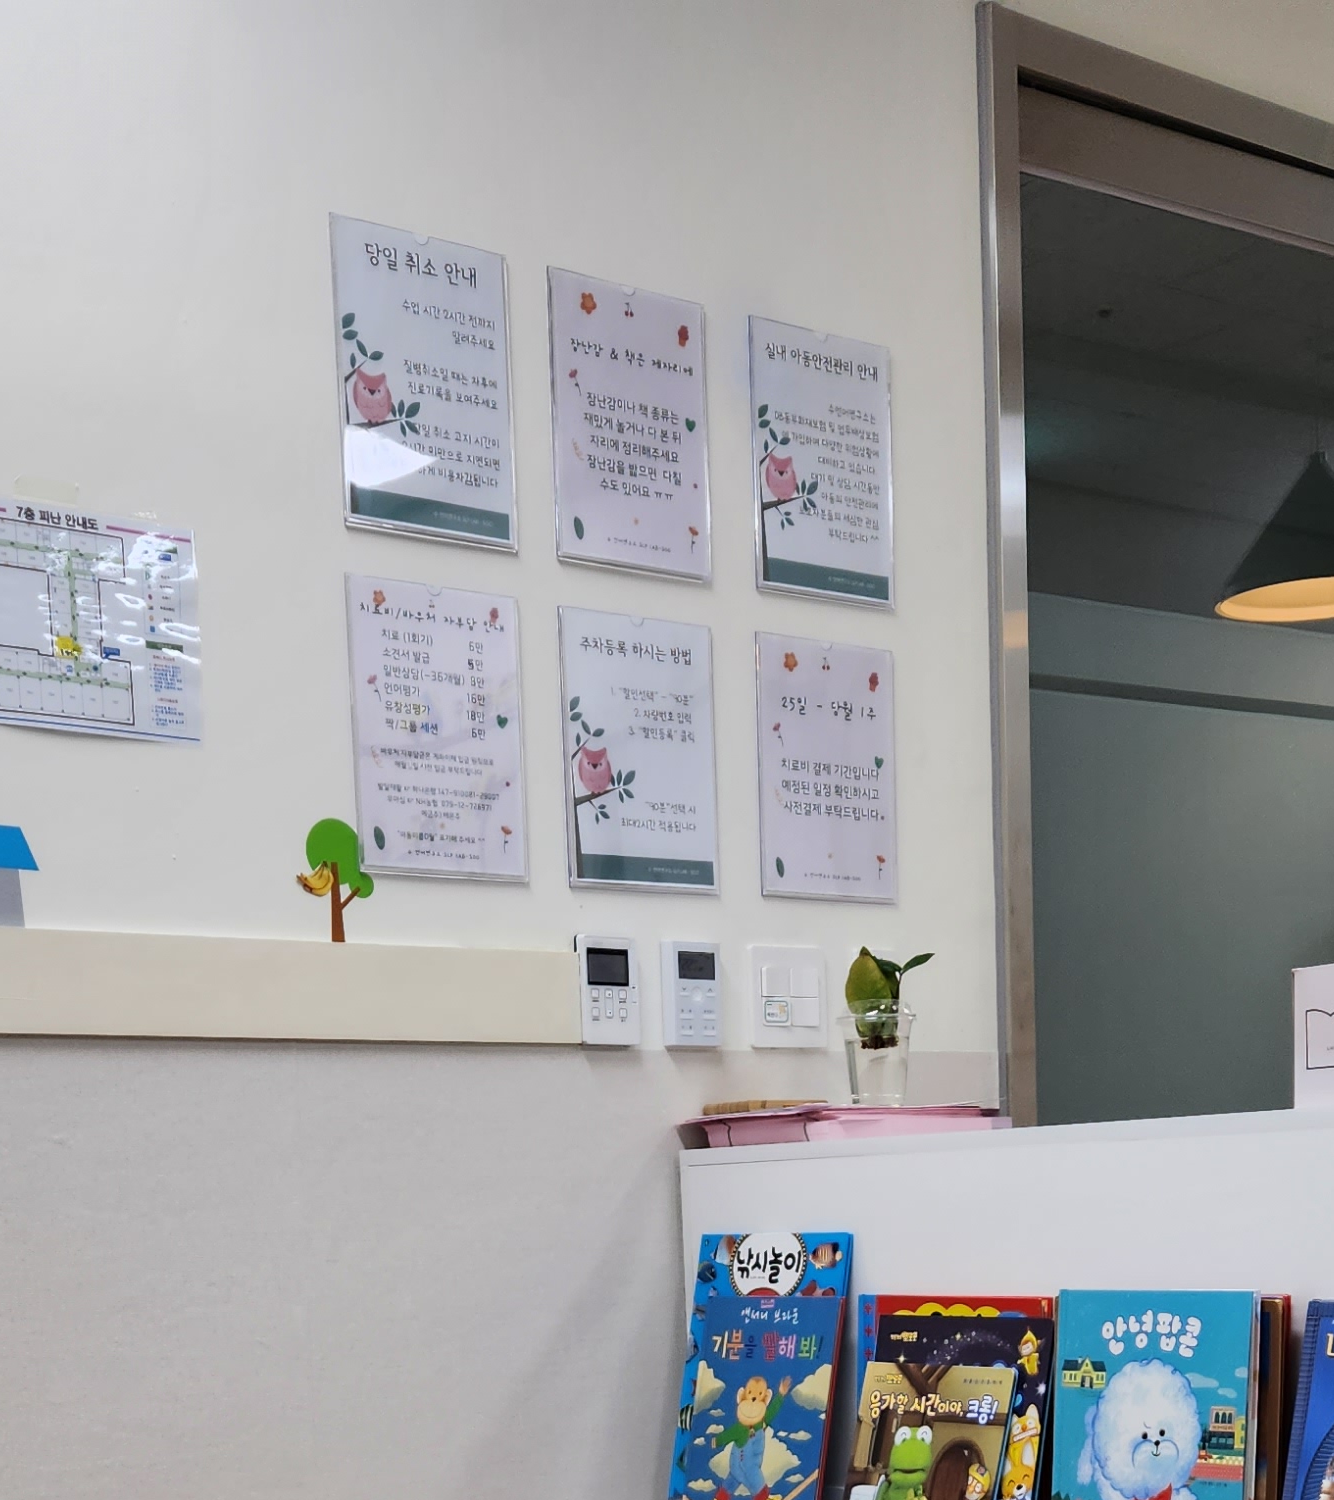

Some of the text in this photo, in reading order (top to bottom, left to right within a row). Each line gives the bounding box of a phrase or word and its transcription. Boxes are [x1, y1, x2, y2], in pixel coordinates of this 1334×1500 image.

[365, 243, 478, 288] 당일 취소 안내
[423, 305, 440, 319] 시간
[443, 309, 466, 325] 2시간
[469, 316, 495, 330] 전까지
[570, 338, 603, 358] 장난감
[610, 348, 619, 361] &
[765, 341, 879, 382] 실내 아동안전관리 안내
[587, 392, 636, 415] 장난감이나
[587, 453, 625, 475] 장난감을
[600, 478, 650, 498] 수도 있어요
[16, 506, 99, 531] 7층 피난 안내도
[382, 629, 399, 640] 치료
[580, 636, 692, 666] 주차등록 하시는 방법
[781, 696, 807, 715] 25일
[781, 757, 879, 781] 치료비 결제 기간입니다
[737, 1246, 801, 1284] 낚시놀이
[774, 1307, 799, 1324] 브라운
[869, 1390, 908, 1419] 응가할
